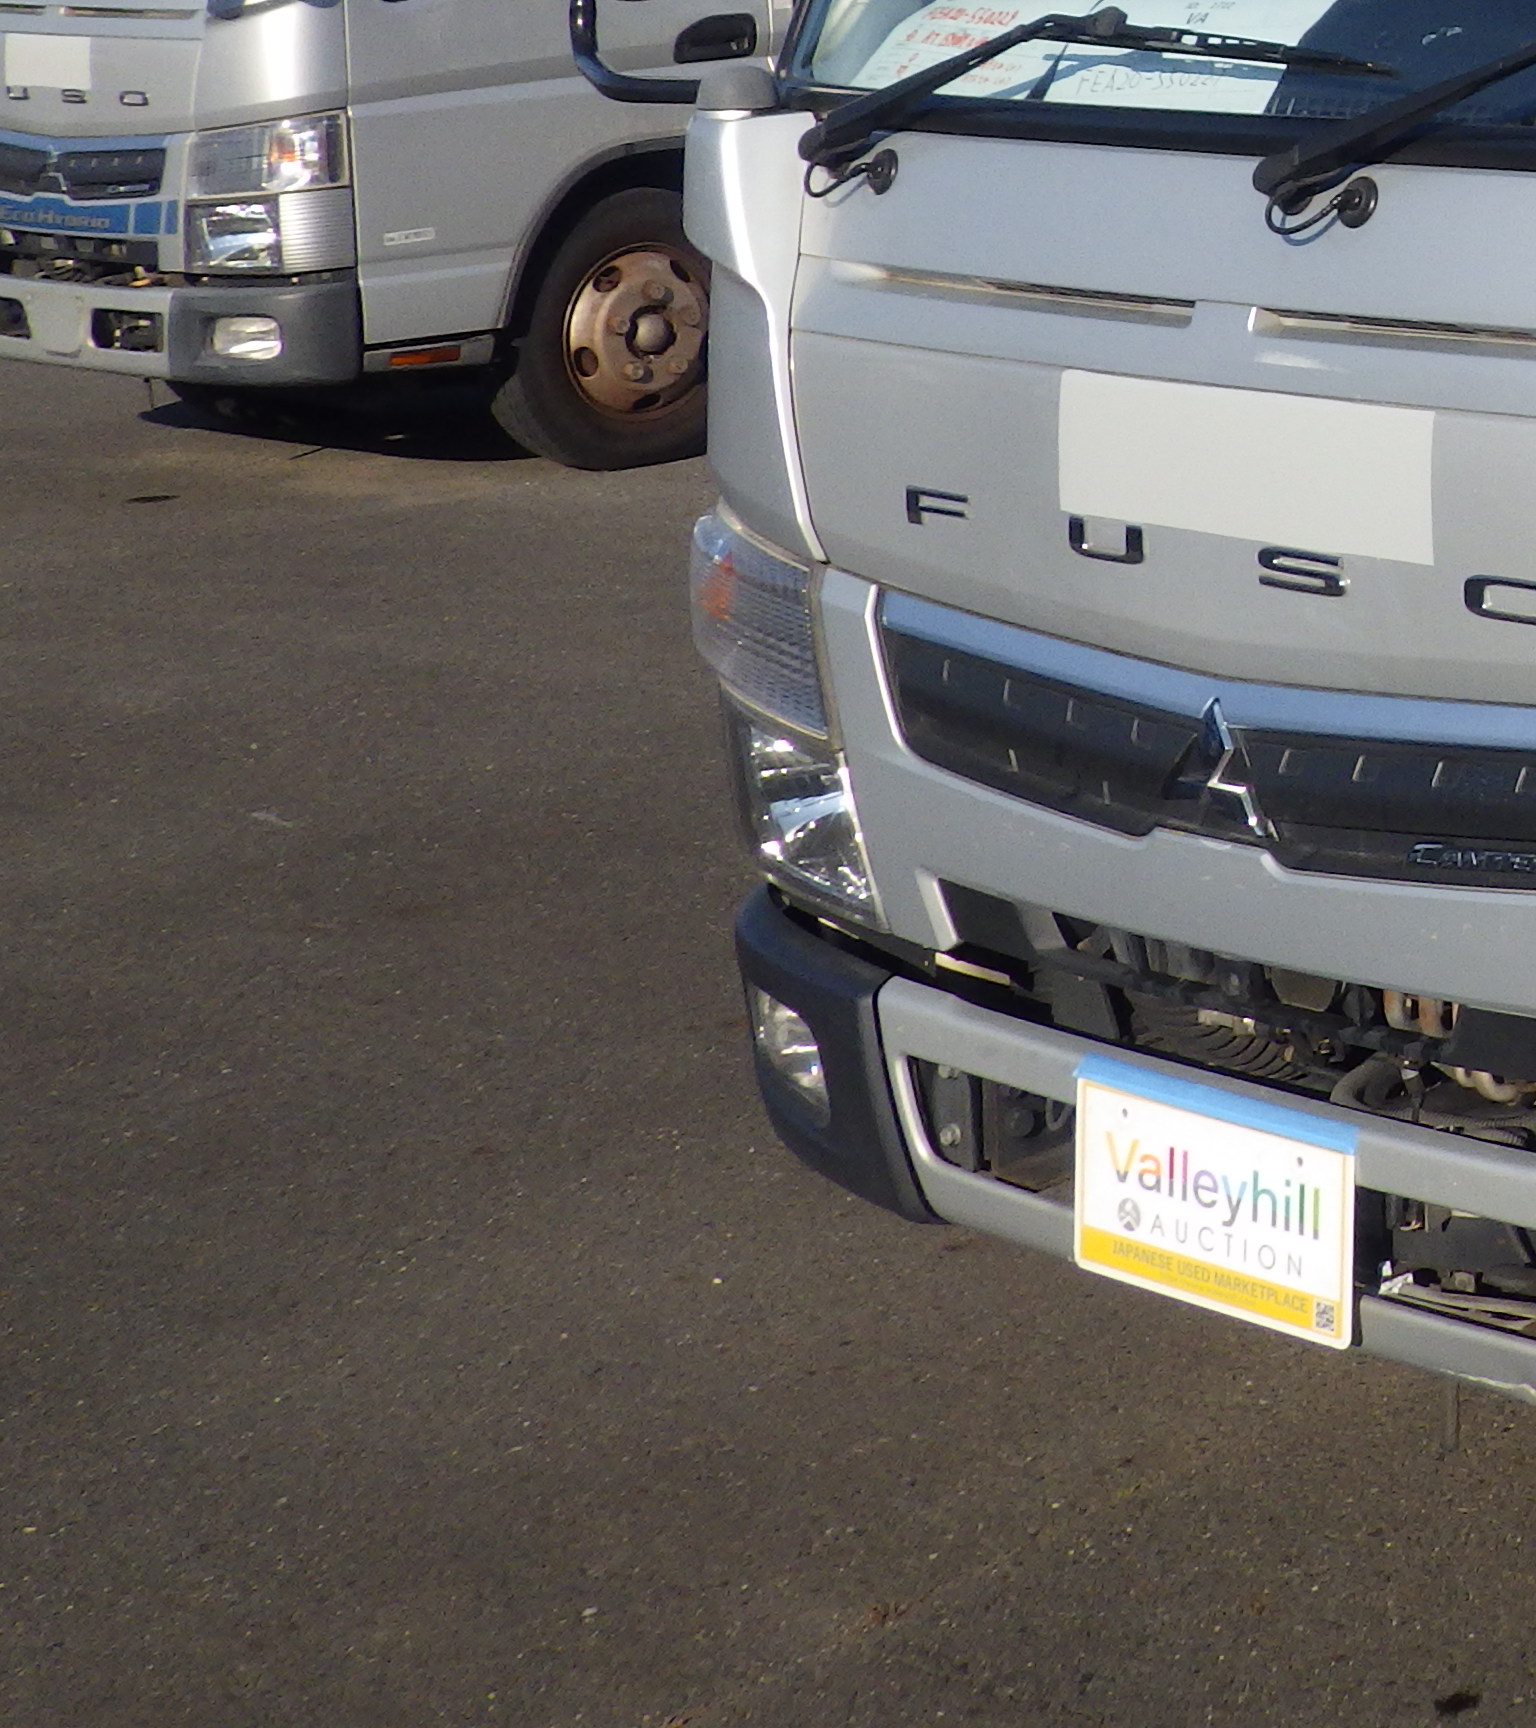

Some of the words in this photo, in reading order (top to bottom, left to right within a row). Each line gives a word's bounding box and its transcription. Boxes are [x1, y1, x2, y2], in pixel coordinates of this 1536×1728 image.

[1106, 1131, 1320, 1240] Valleyhill
[1113, 1240, 1173, 1271] JAPANESE
[1177, 1260, 1211, 1283] USED
[1214, 1272, 1309, 1313] MARKETPLACE
[1150, 1213, 1302, 1277] AUCTION
